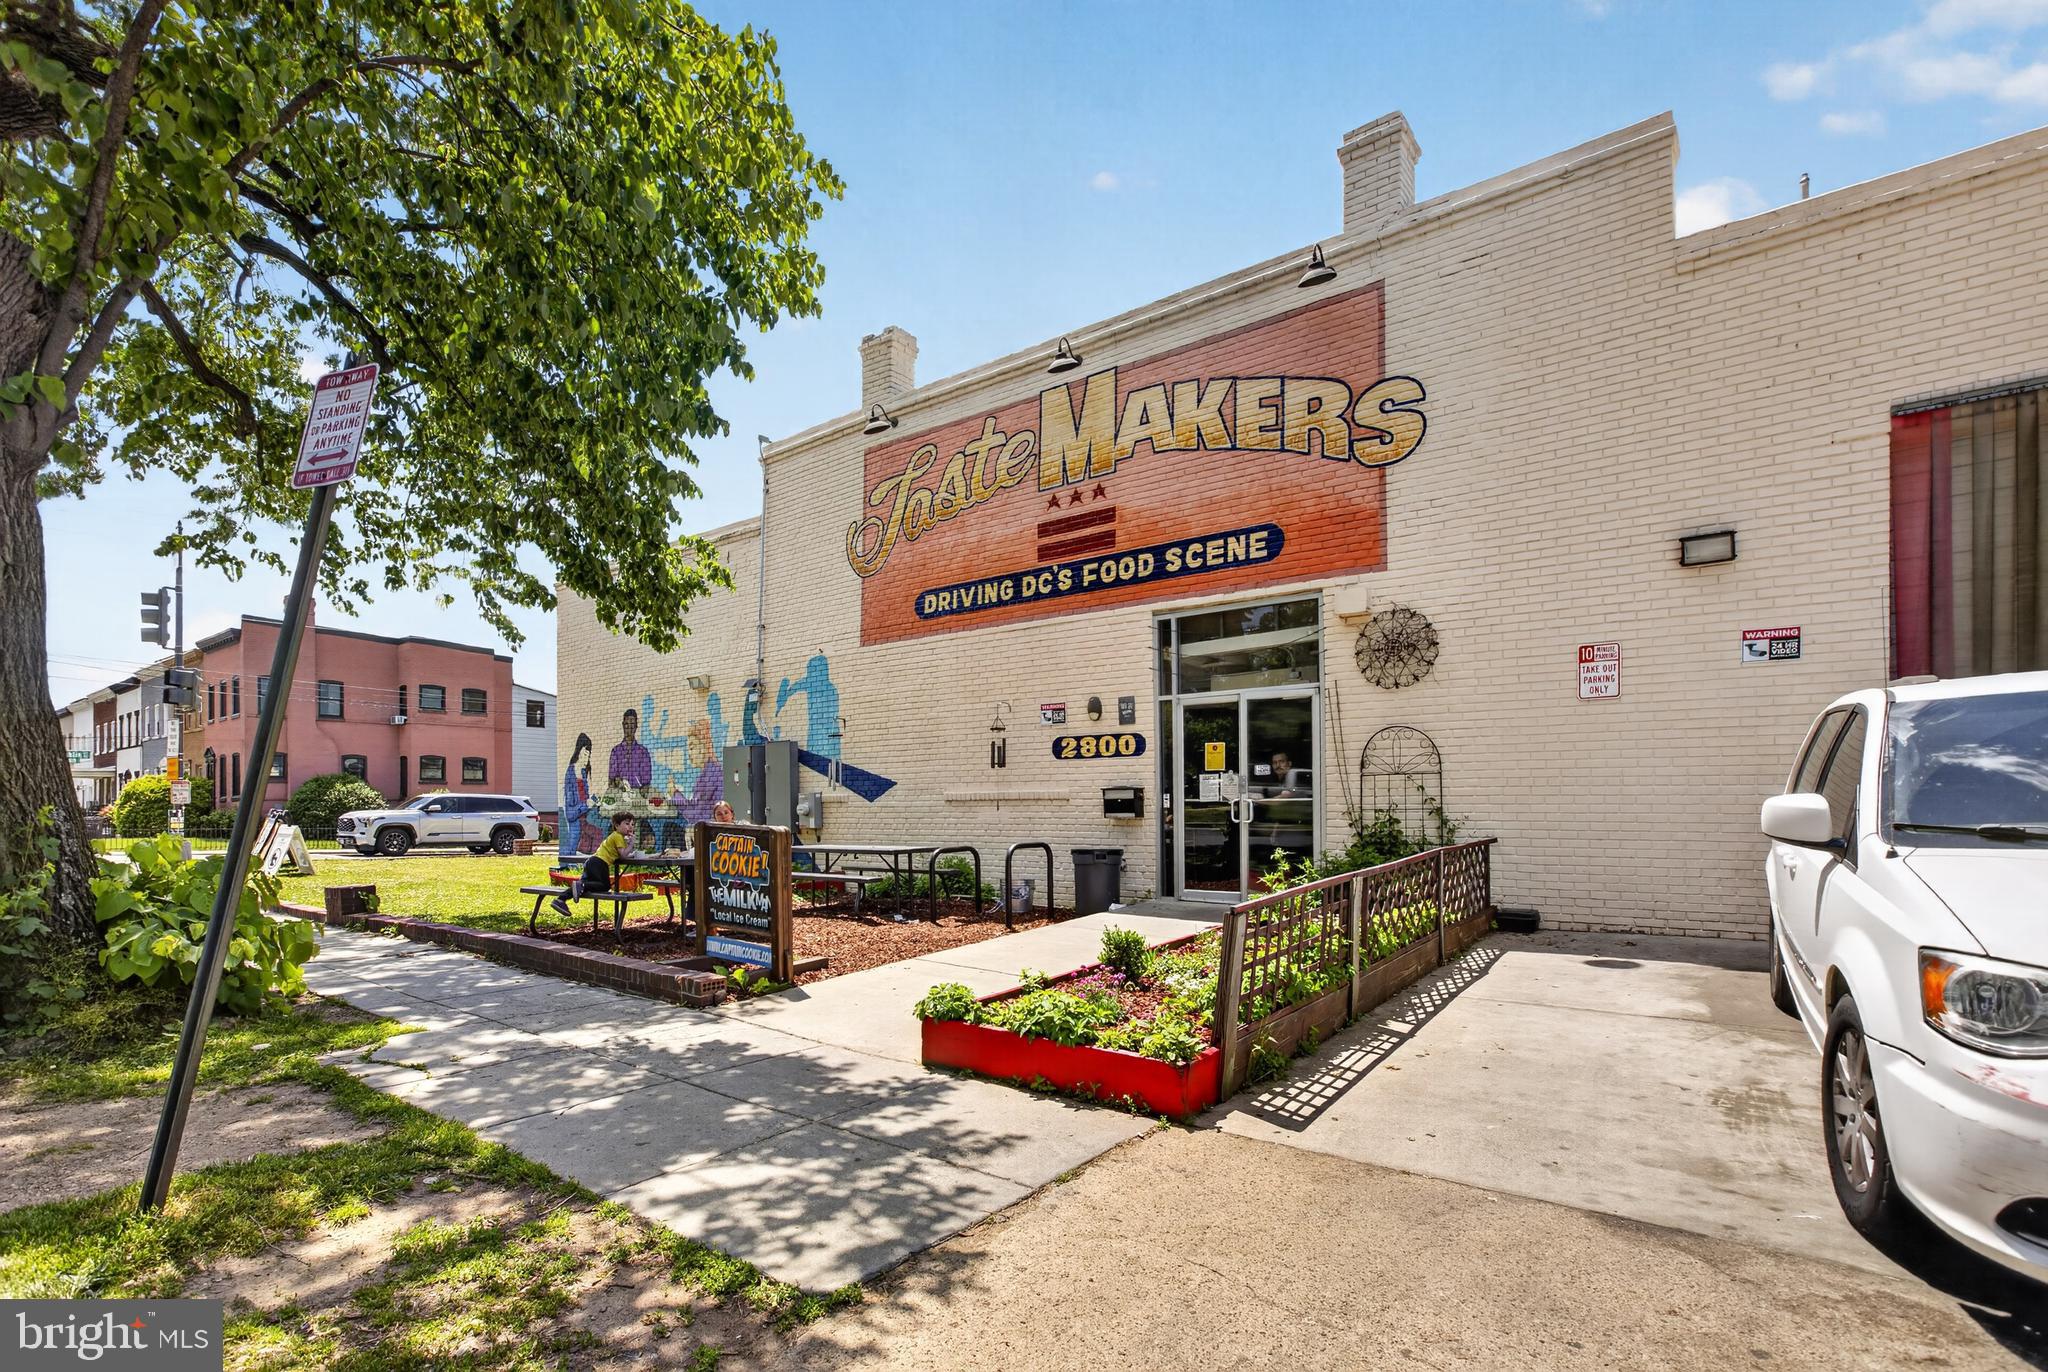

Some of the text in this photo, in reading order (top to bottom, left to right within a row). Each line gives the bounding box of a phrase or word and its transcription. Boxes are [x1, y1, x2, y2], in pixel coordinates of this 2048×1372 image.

[326, 375, 344, 388] TOW
[336, 389, 352, 402] NO
[317, 401, 362, 420] STANDING
[320, 415, 361, 434] PARKING
[313, 432, 353, 450] ANYTIME
[846, 366, 1426, 578] Taste MAKERS
[923, 531, 1269, 614] DRIVING DC'S FOOD SCENE
[1745, 629, 1799, 639] WARNING
[1581, 647, 1594, 661] 10
[1596, 651, 1618, 659] PARKING
[1582, 663, 1617, 674] TAKE OUT
[1583, 674, 1616, 685] PARKING
[1589, 685, 1609, 695] ONLY
[1061, 734, 1137, 758] 2800
[716, 835, 754, 854] CAPTAIN
[708, 886, 724, 903] THE
[733, 911, 744, 924] Ice
